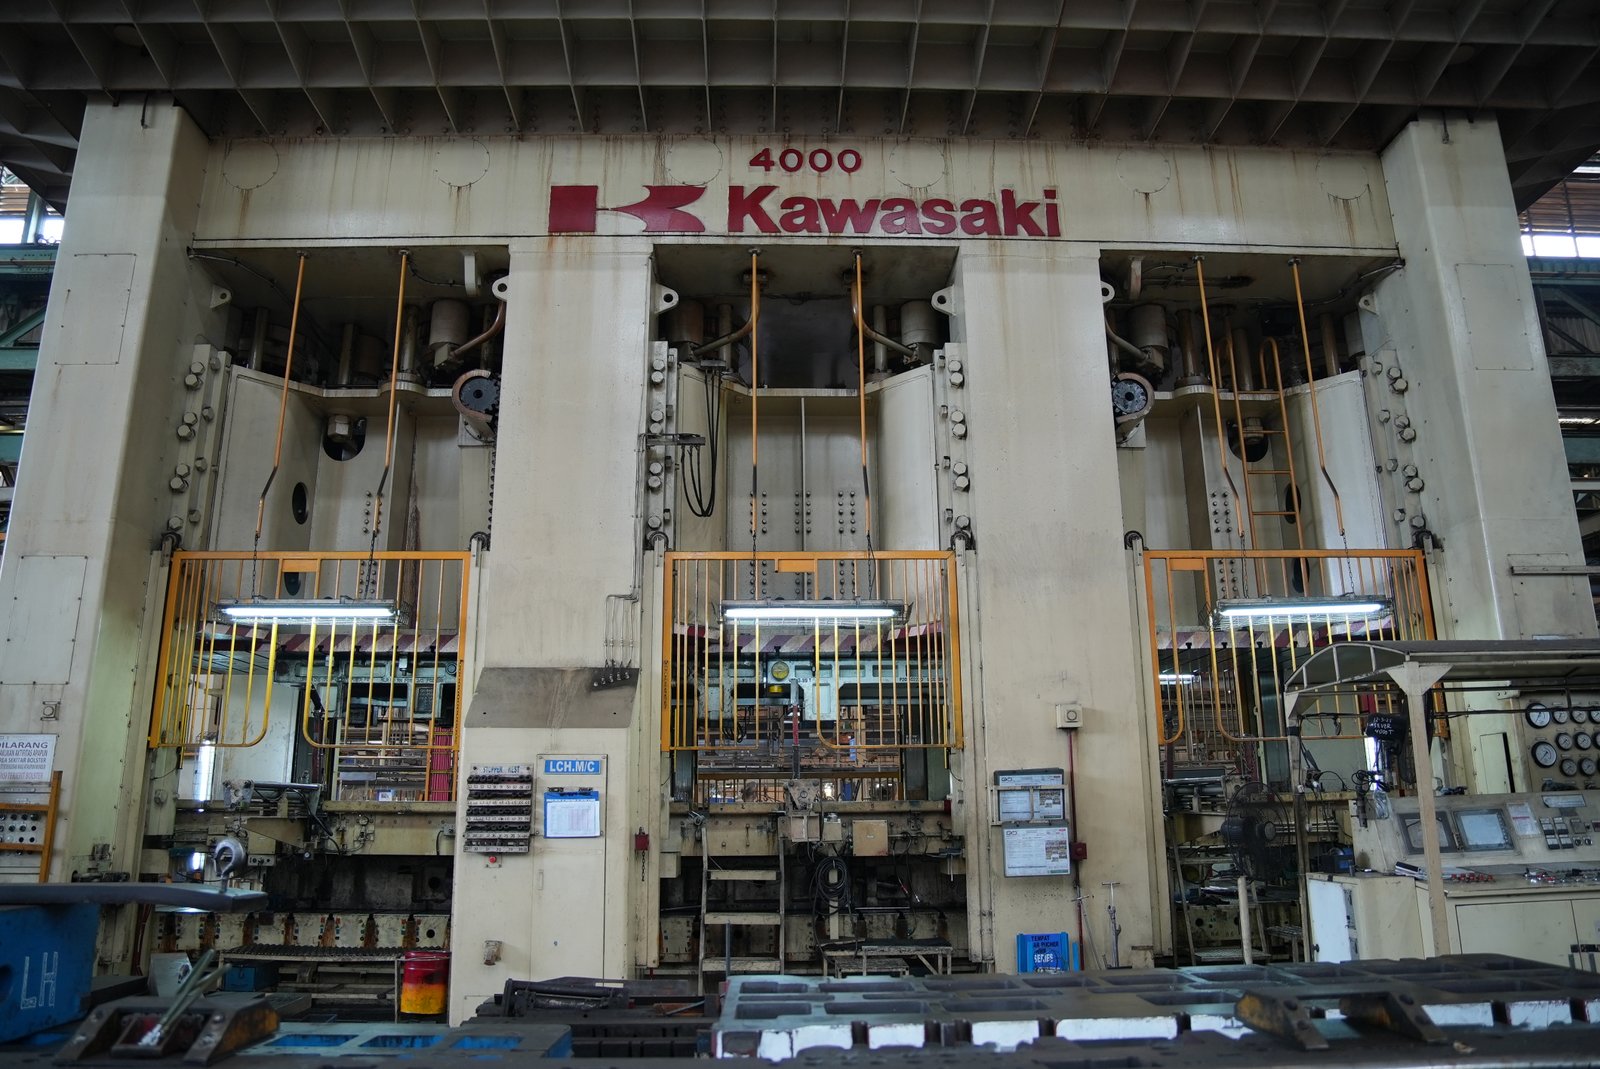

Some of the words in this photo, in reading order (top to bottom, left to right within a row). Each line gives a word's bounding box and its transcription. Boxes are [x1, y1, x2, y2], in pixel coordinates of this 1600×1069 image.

[749, 147, 863, 174] 4000
[727, 185, 1061, 237] Kawasaki
[0, 741, 48, 749] ILARANG
[549, 760, 595, 773] LCH.M/C
[20, 951, 58, 1010] LH
